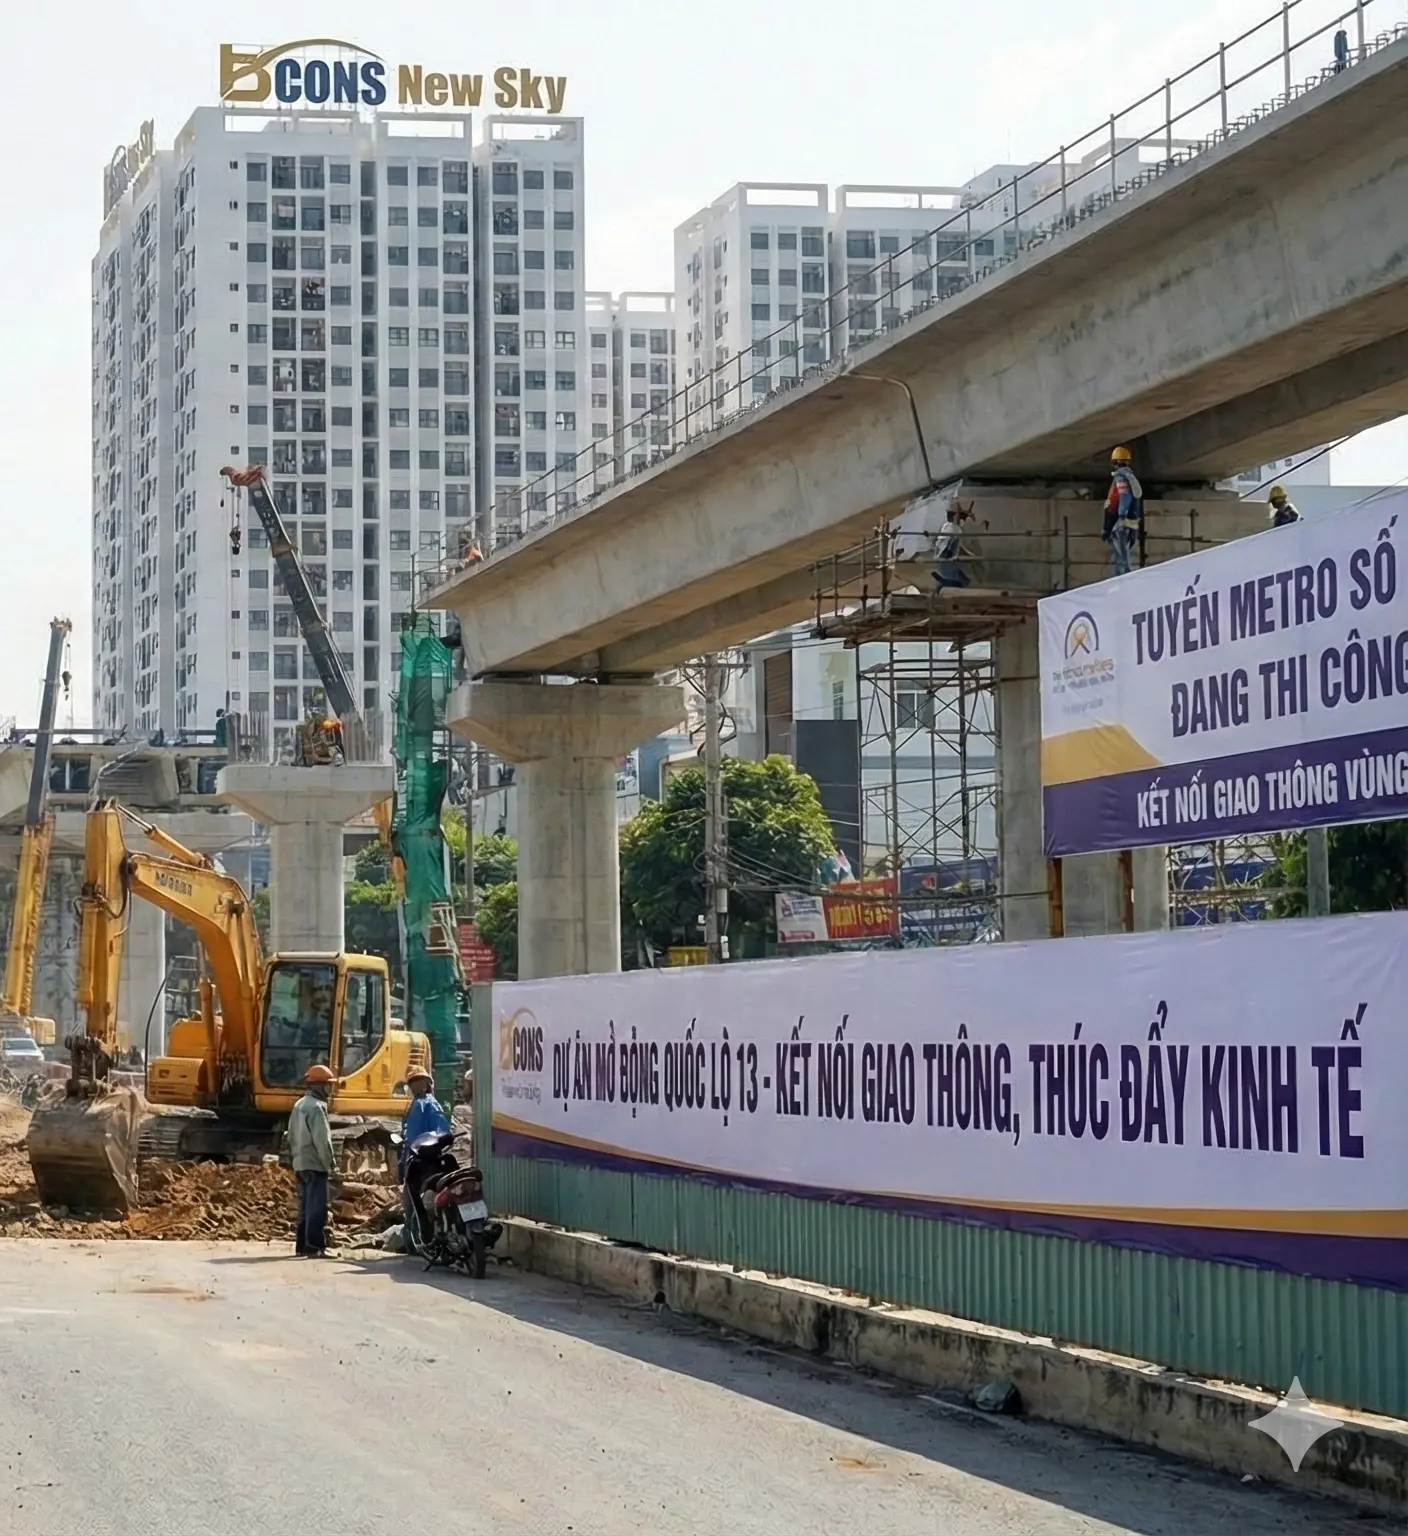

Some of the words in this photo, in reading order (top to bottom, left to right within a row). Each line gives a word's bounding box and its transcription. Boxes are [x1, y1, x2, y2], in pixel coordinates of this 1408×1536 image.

[398, 65, 483, 106] New
[494, 67, 567, 114] Sky
[1132, 574, 1220, 665] TUYẾN
[1230, 557, 1338, 641] METRO
[1349, 515, 1398, 610] SỐ
[1171, 668, 1249, 738] ĐANG
[1258, 654, 1309, 721] THI
[1320, 628, 1408, 709] CÔNG
[1137, 776, 1170, 829] KẾT
[1175, 769, 1208, 824] NỐI
[1213, 774, 1260, 819] GIAO
[1265, 758, 1339, 812] THÔNG
[1345, 748, 1408, 801] VÙNG
[553, 1037, 571, 1112] DỰ
[664, 1018, 706, 1112] QUỐC
[736, 1043, 759, 1114] 13
[776, 1015, 812, 1117] KẾT
[817, 1014, 854, 1120] NỐI
[861, 1042, 916, 1126] GIAO
[922, 1023, 1021, 1146] THÔNG,
[1028, 1022, 1110, 1141] THÚC
[1119, 1000, 1190, 1146] ĐẨY
[1201, 1045, 1299, 1154] KINH
[1311, 1002, 1369, 1159] TẾ
